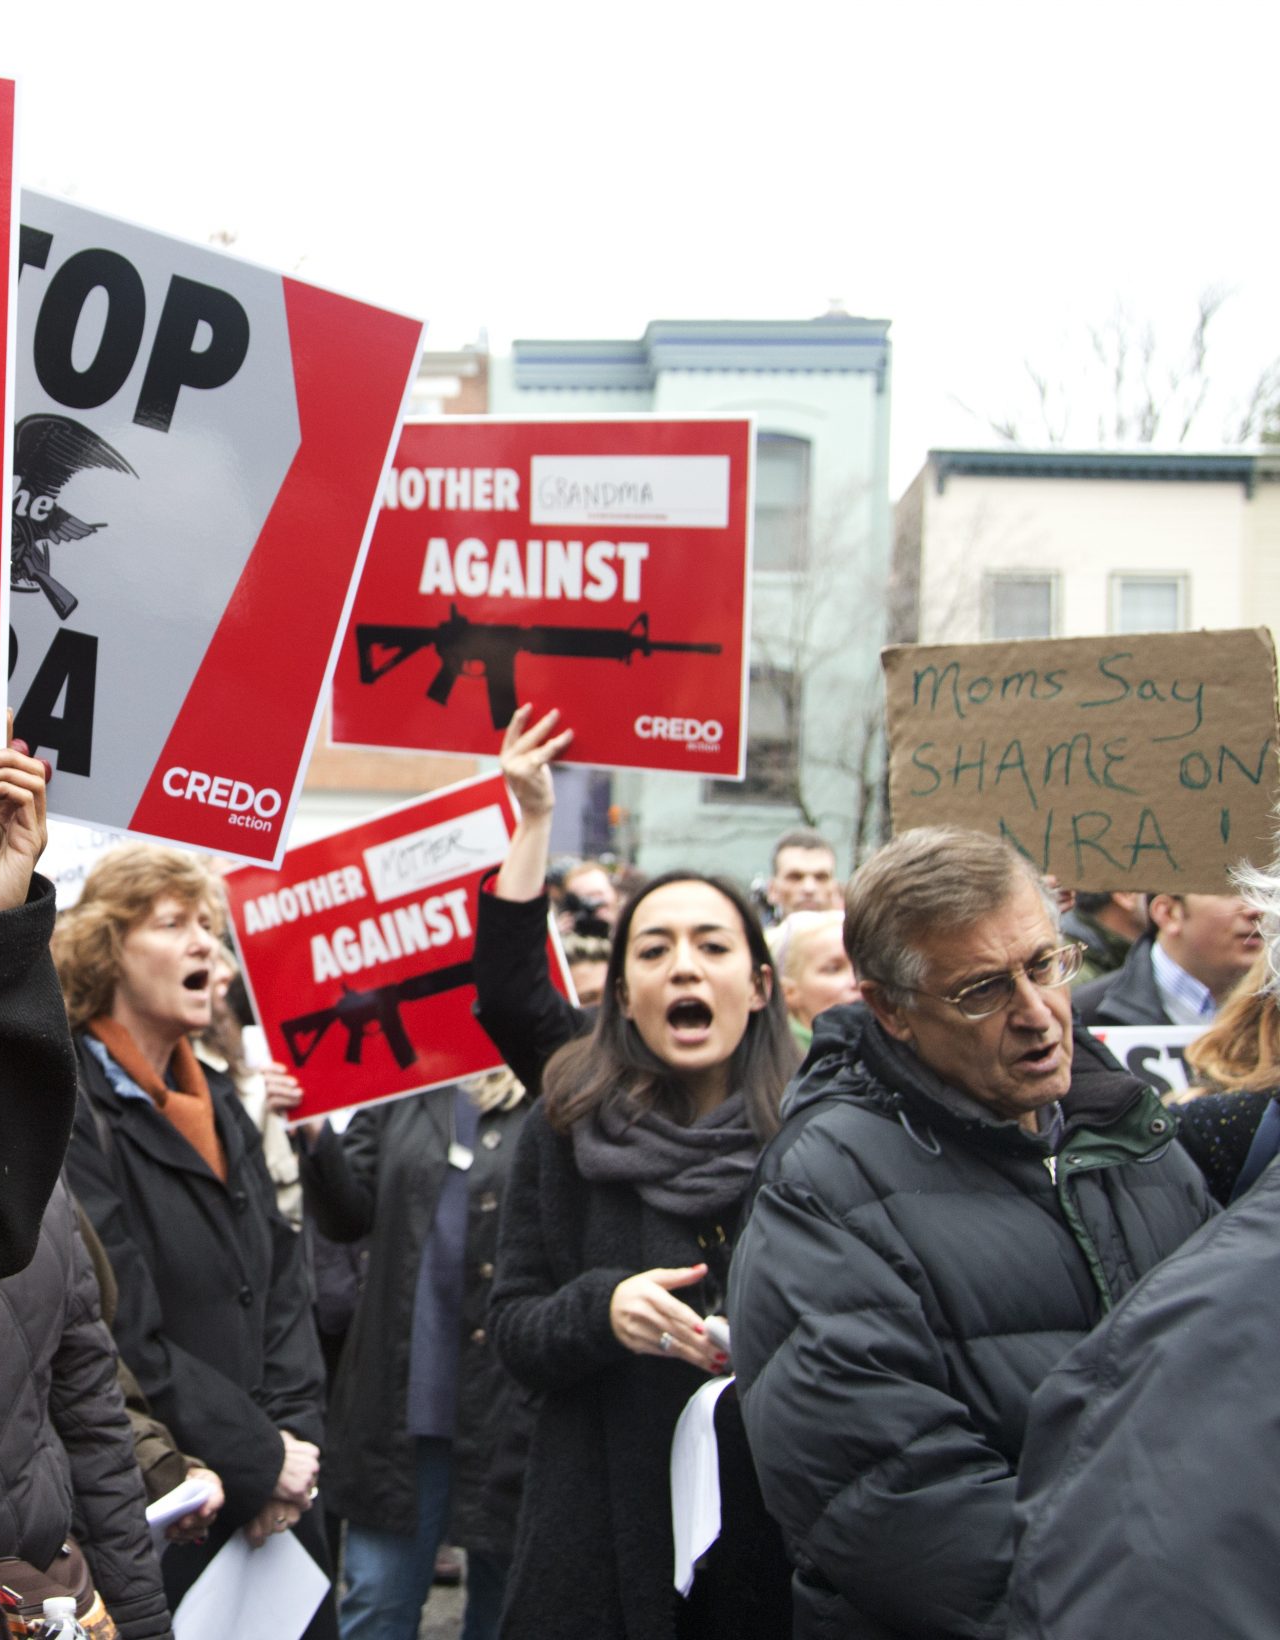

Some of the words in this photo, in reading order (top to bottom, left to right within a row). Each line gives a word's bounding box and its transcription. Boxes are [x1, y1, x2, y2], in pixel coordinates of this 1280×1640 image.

[538, 474, 654, 510] GRANDMA
[419, 537, 650, 602] AGAINST
[8, 624, 99, 778] A
[634, 715, 724, 743] CREDO
[1077, 652, 1205, 743] Say
[162, 766, 282, 818] CREDO
[909, 732, 1144, 811] SHAME
[1178, 737, 1273, 791] ON
[227, 813, 273, 833] action
[243, 865, 367, 936] ANOTHER
[310, 888, 472, 984] AGAINST
